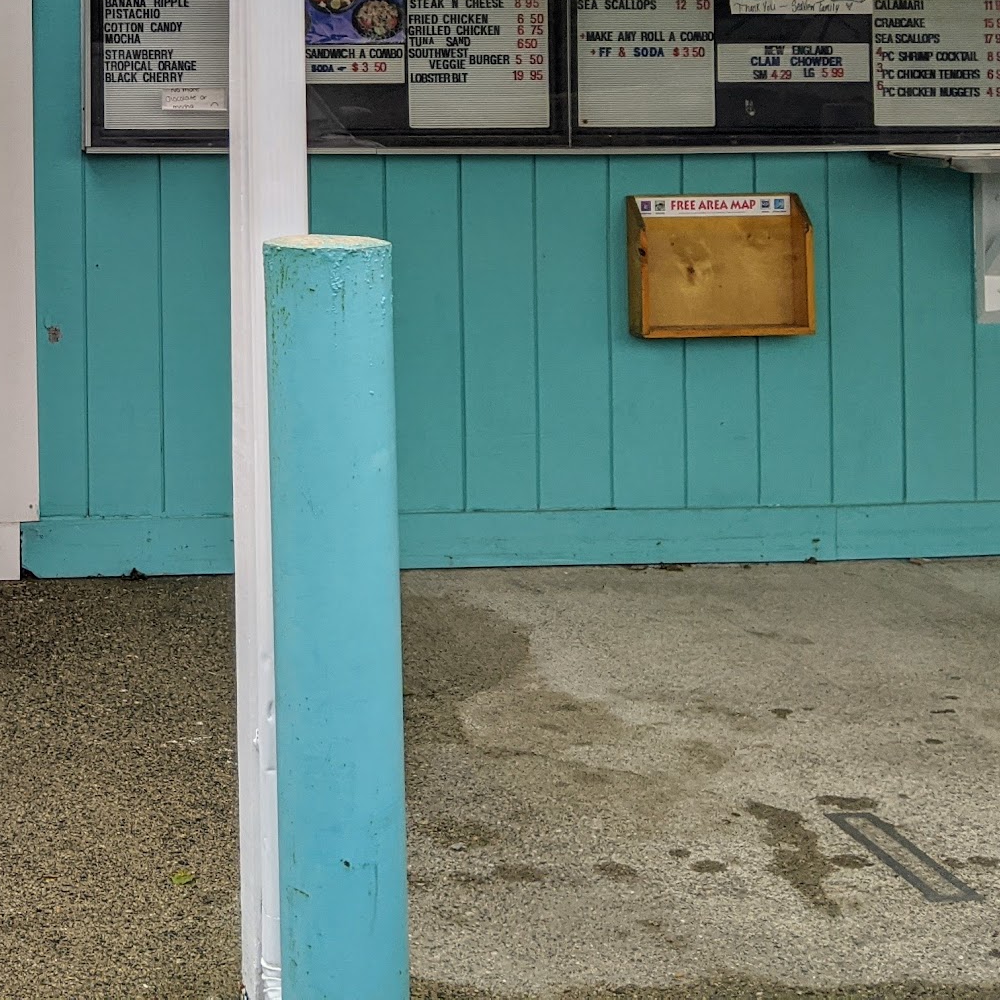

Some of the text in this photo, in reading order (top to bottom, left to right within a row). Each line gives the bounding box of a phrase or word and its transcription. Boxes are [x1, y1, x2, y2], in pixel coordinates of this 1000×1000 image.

[577, 0, 657, 10] SEA SCALLOPS
[734, 3, 760, 11] Thank
[105, 9, 160, 19] PISTACHIO
[409, 14, 488, 24] FRIED CHICKEN
[104, 22, 183, 32] COTTON CANDY
[408, 26, 500, 36] GRILLED CHICKEN
[105, 34, 141, 43] MOCHA
[875, 34, 940, 43] SEA SCALLOPS
[105, 49, 173, 59] STRAWBERRY
[408, 48, 469, 58] SOUTHWEST
[765, 45, 833, 55] NEW ENGLAND
[429, 60, 466, 69] VEGGIE
[469, 55, 510, 64] BURGER
[751, 57, 842, 66] CLAM CHOWDER
[105, 61, 196, 71] TROPICAL ORANGE
[105, 73, 183, 82] BLACK CHERRY
[670, 200, 756, 211] FREE AREA MAP
